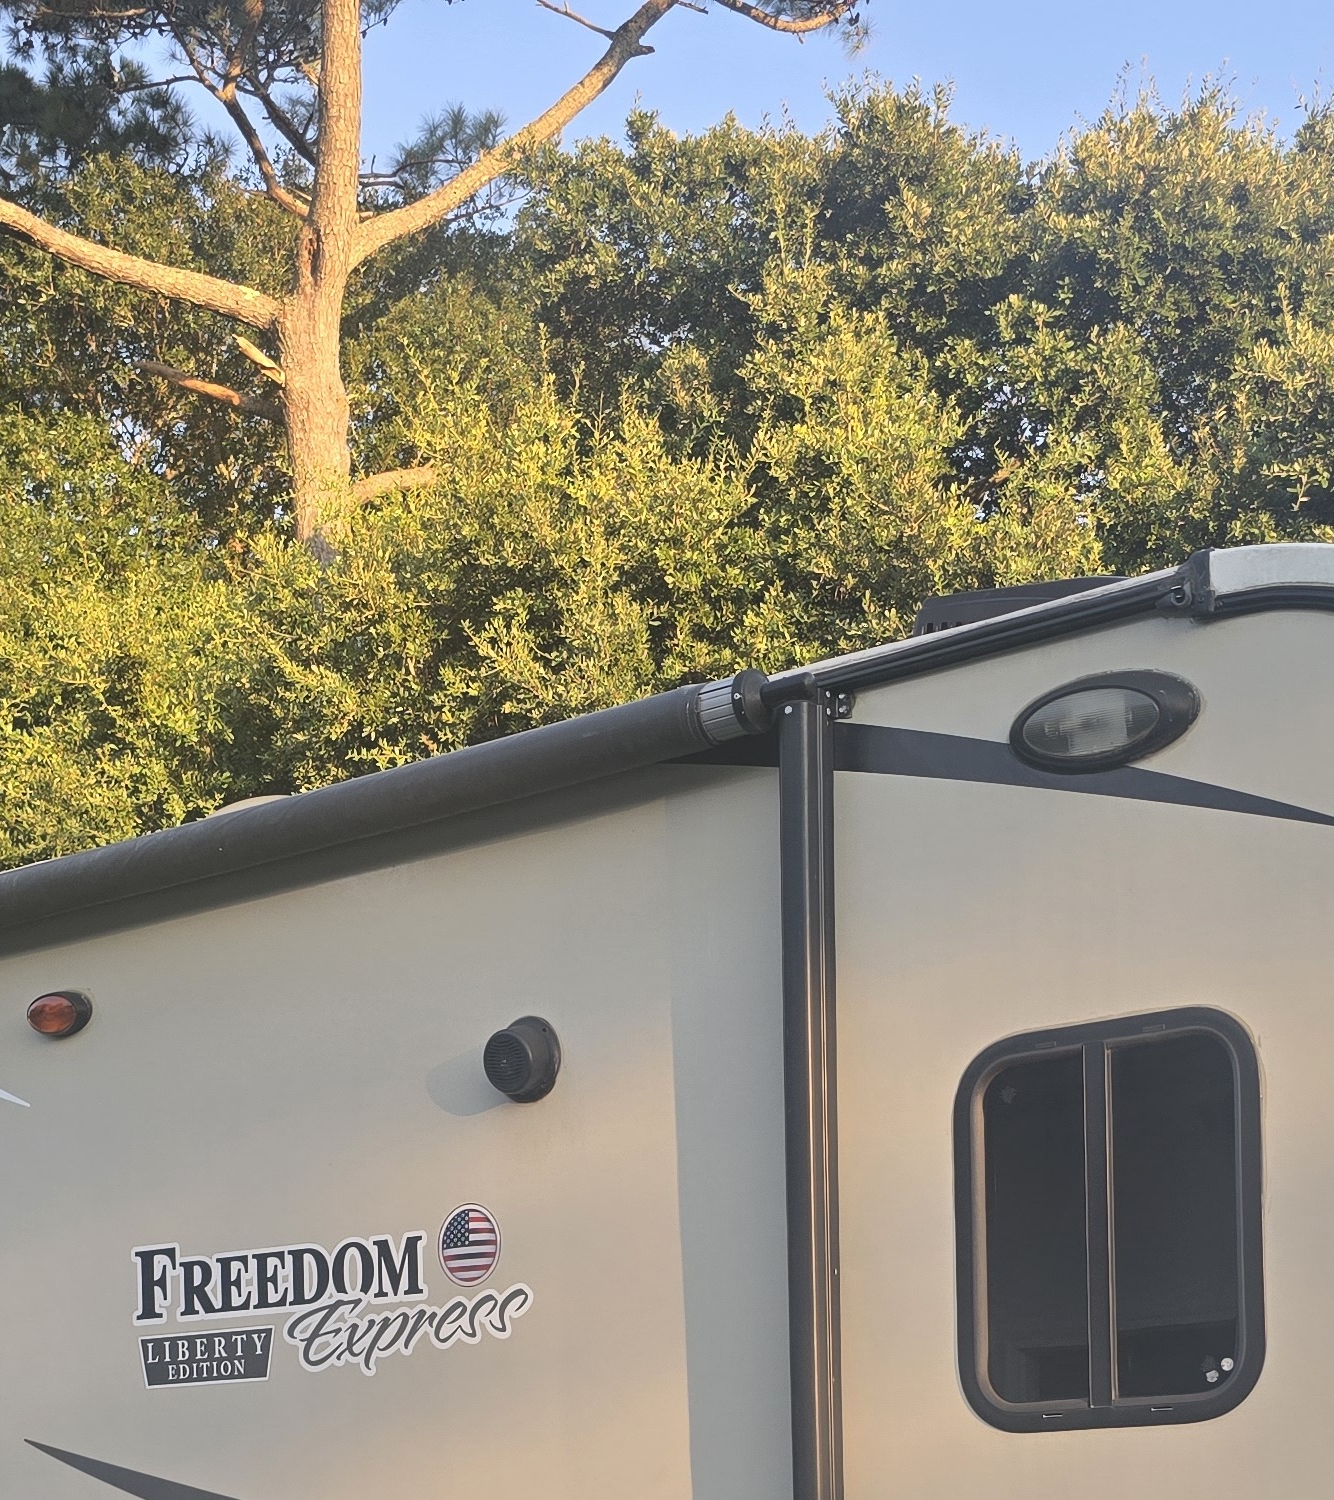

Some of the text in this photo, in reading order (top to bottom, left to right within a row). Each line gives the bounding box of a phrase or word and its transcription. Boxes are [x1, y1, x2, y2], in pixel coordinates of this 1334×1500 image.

[134, 1235, 424, 1321] FREEDOM
[147, 1334, 267, 1365] LIBERTY
[287, 1288, 529, 1371] Express
[168, 1359, 246, 1381] EDITION
